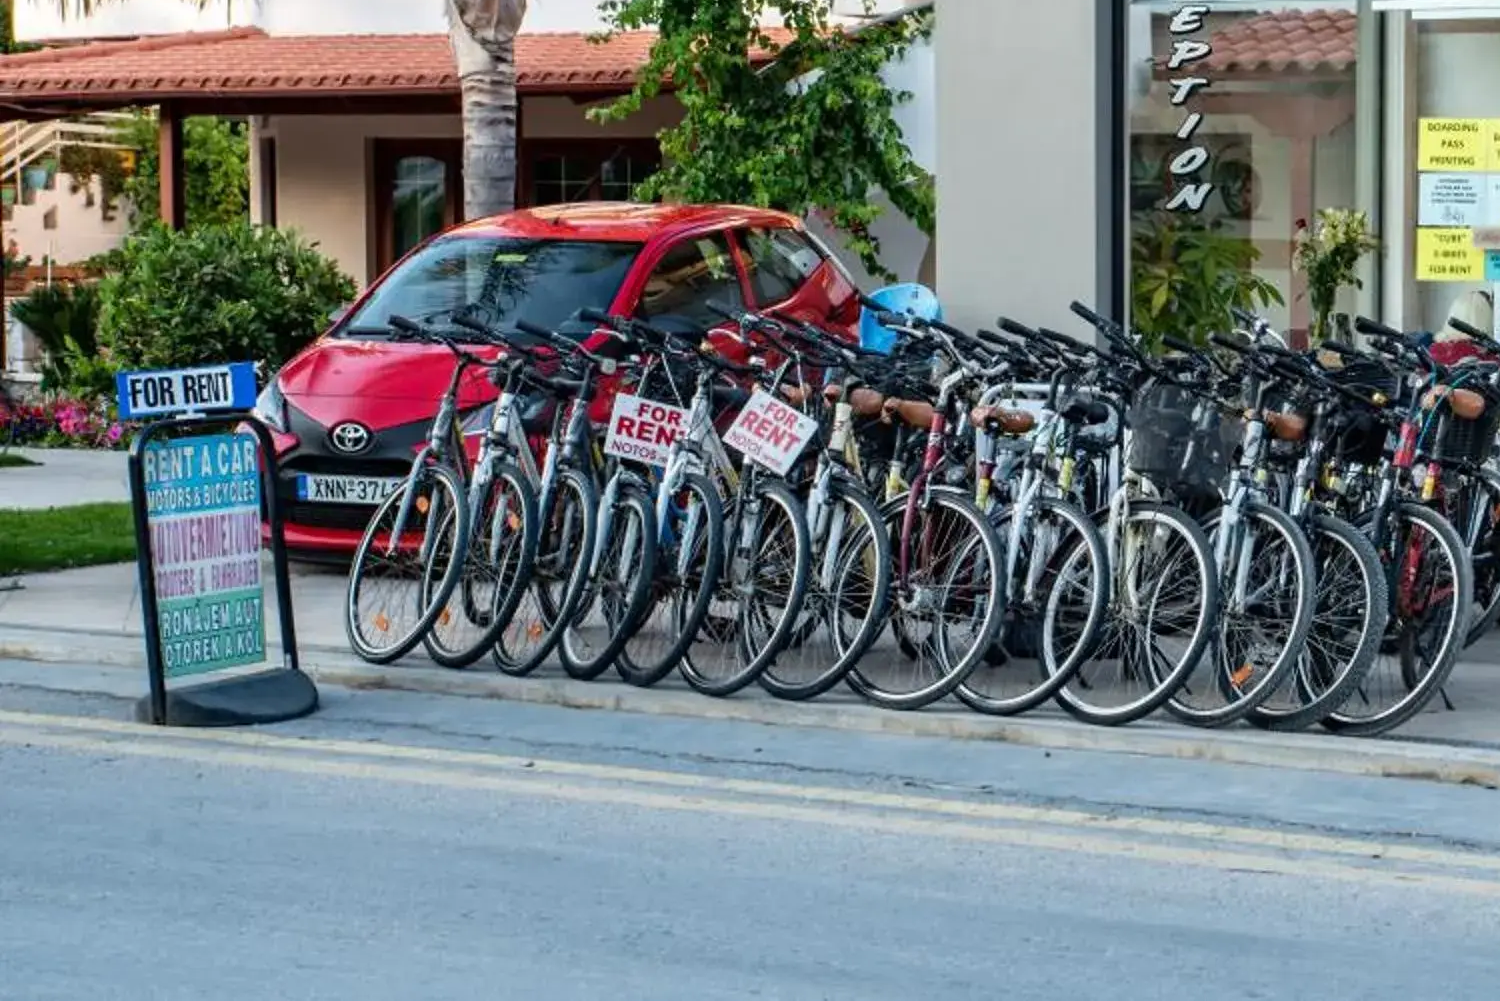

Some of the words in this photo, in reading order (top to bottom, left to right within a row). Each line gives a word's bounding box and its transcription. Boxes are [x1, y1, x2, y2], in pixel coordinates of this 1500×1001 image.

[1427, 122, 1479, 133] BOARDING
[1441, 139, 1465, 149] PASS
[1429, 155, 1475, 166] PRINTING
[1429, 265, 1447, 274] FOR
[1449, 265, 1472, 274] RENT
[129, 376, 175, 408] FOR
[182, 372, 229, 404] RENT
[638, 403, 681, 425] FOR
[764, 401, 799, 428] FOR
[739, 410, 800, 452] RENT
[144, 444, 194, 482] RENT
[201, 445, 211, 477] A
[217, 440, 255, 476] CAR
[611, 440, 656, 459] NOTOS
[147, 486, 191, 511] MOTORS
[204, 480, 256, 505] BICYCLES
[157, 511, 259, 565] UTOVERMIETUNG
[238, 630, 262, 655] KOL
